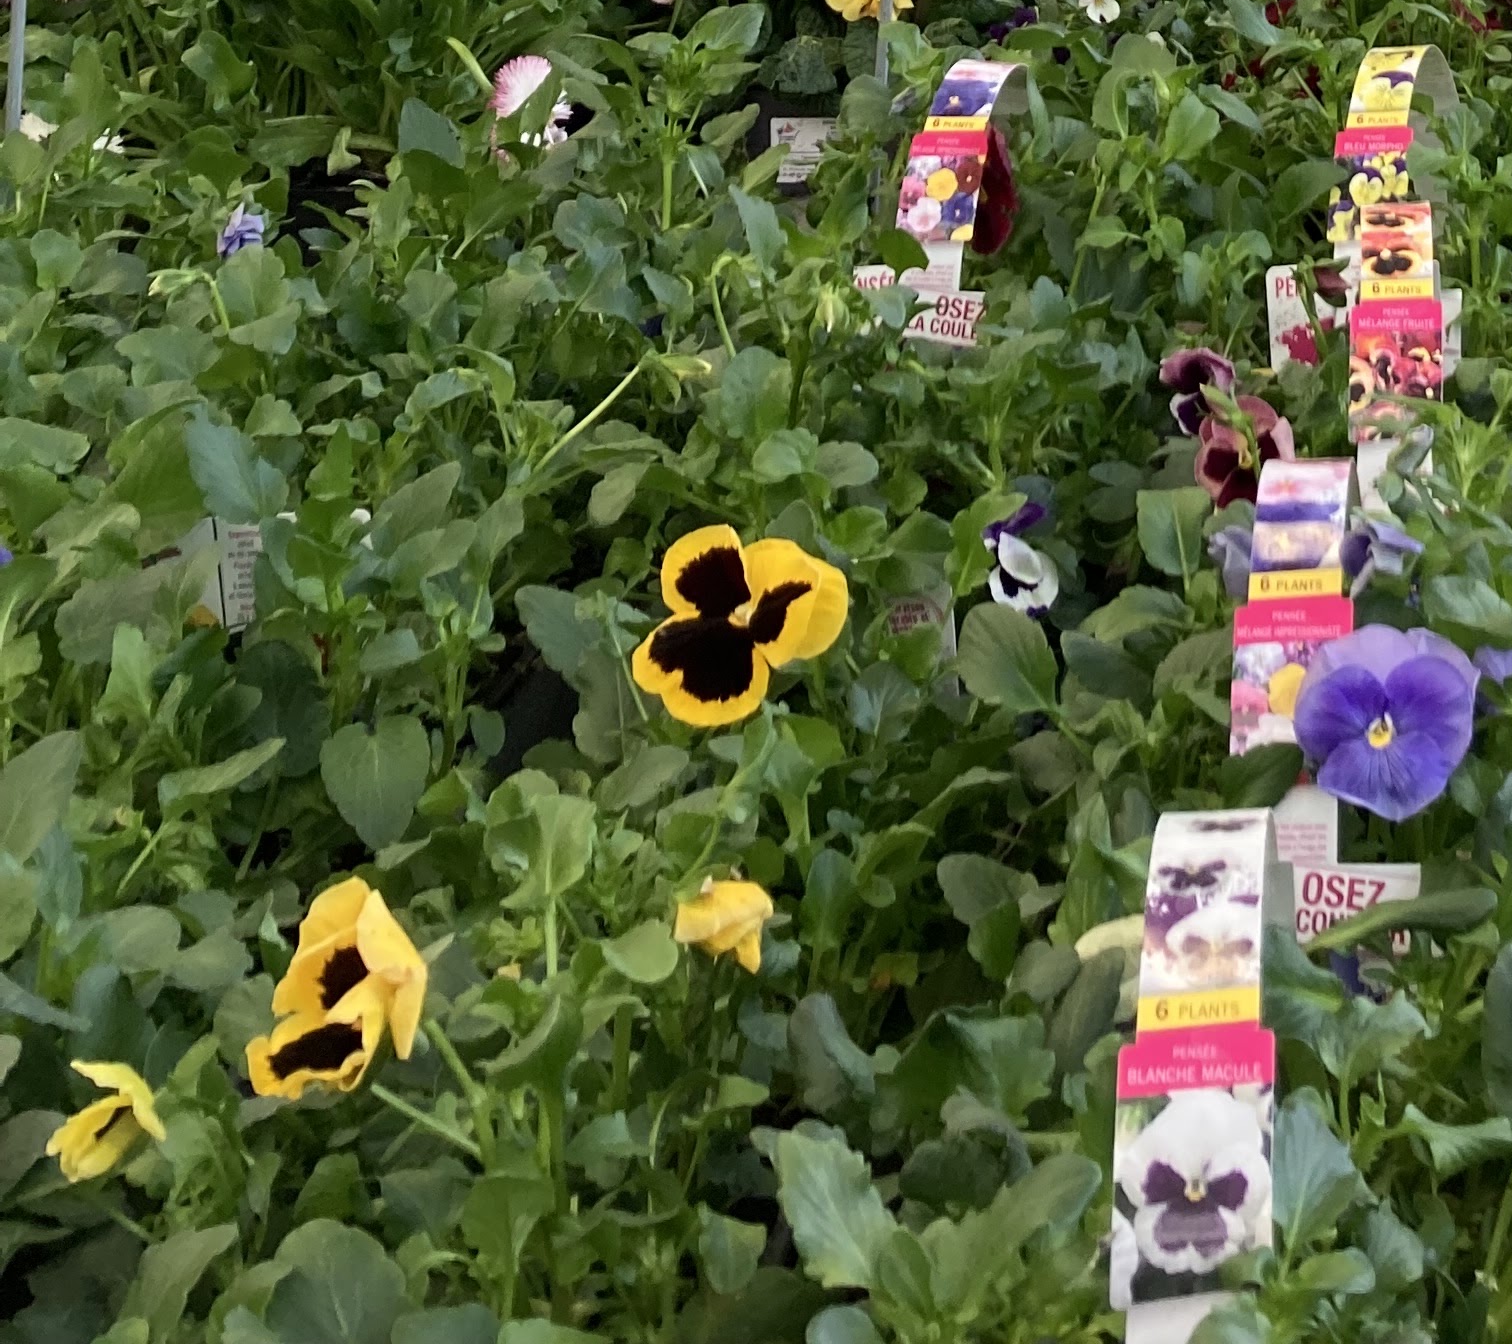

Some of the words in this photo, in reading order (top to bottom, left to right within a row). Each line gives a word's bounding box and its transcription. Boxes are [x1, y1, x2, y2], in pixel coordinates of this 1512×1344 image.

[1372, 283, 1380, 293] 6
[1384, 285, 1421, 295] PLANTS
[1276, 578, 1323, 591] PLANTS
[1302, 872, 1386, 912] OSEZ
[1156, 1000, 1168, 1020] 6
[1179, 1001, 1240, 1019] PLANTS
[1127, 1066, 1196, 1086] BLANCHE
